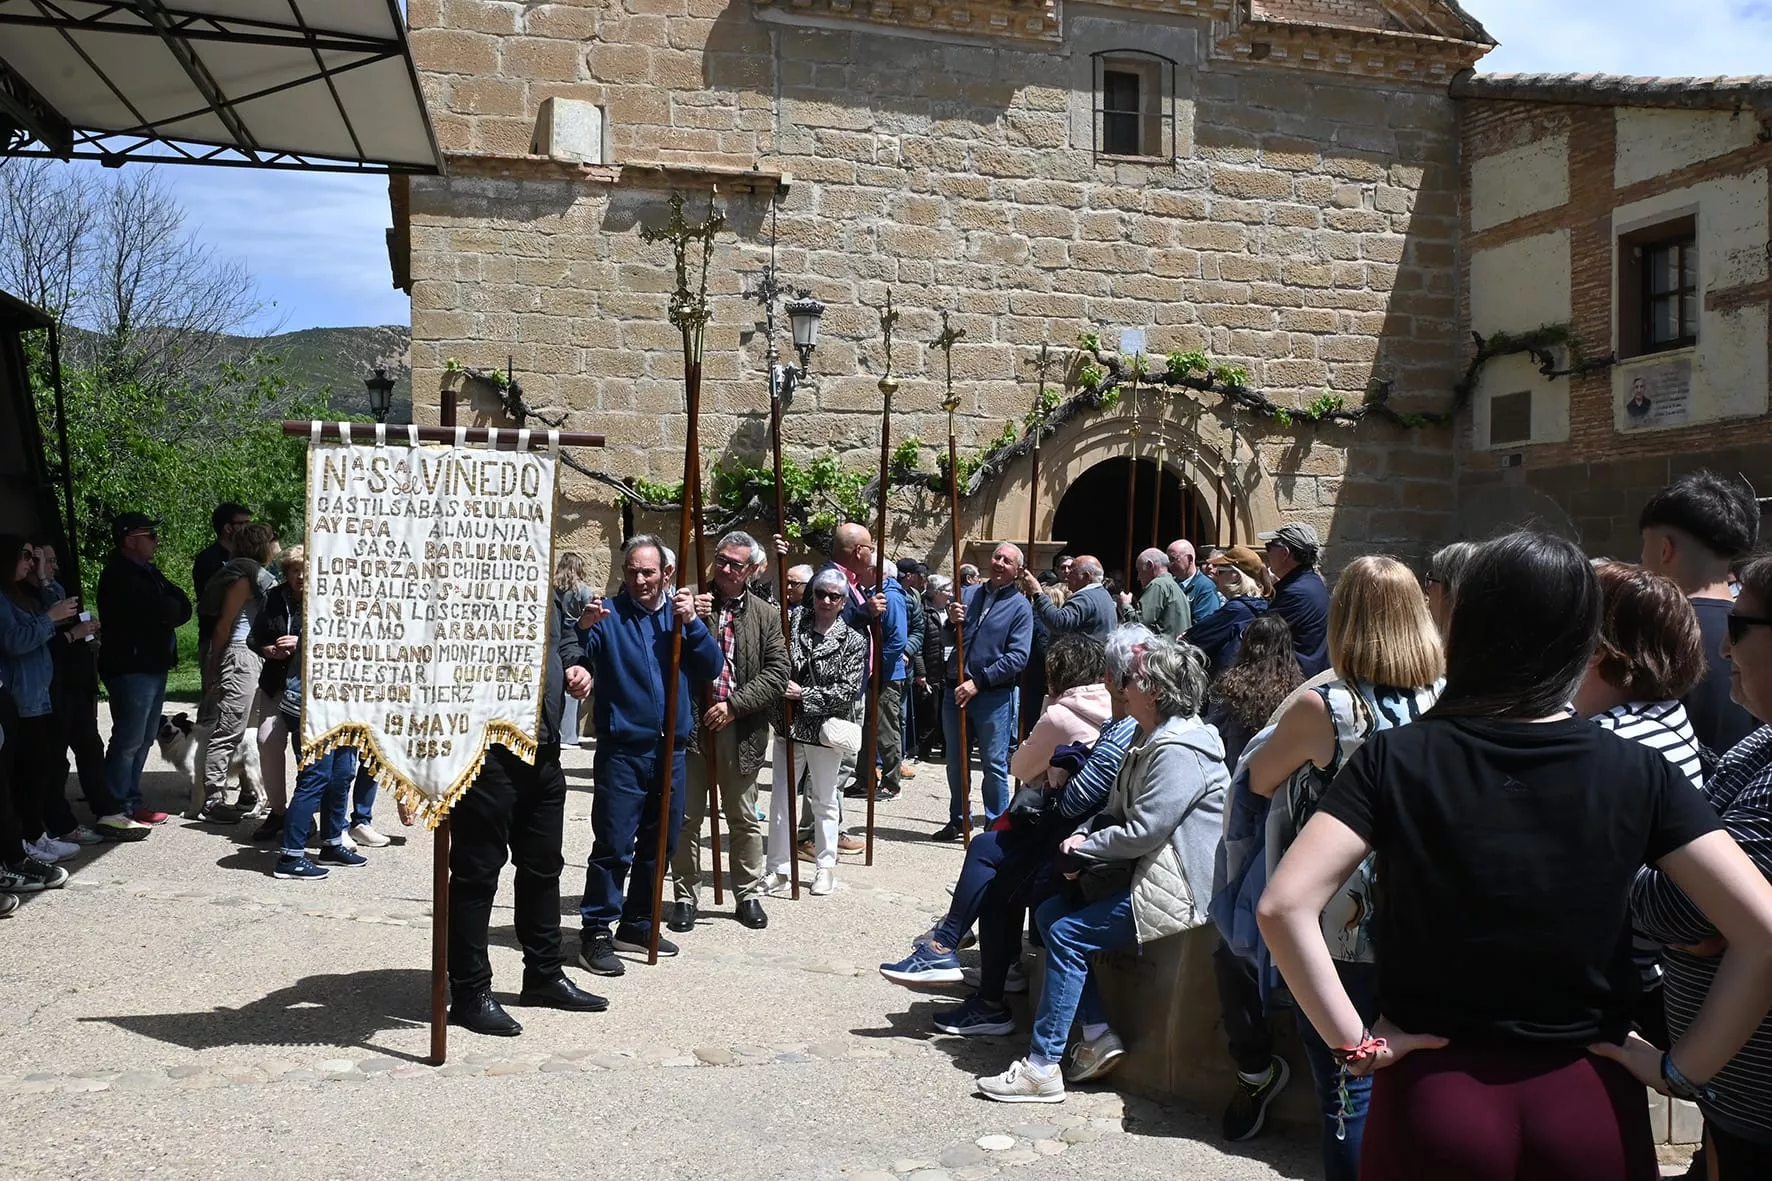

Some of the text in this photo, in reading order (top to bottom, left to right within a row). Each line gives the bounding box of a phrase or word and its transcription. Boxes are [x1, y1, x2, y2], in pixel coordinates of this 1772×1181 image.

[389, 474, 422, 495] del
[422, 455, 540, 498] VIÑEDO
[318, 496, 459, 519] CASTILSABAS
[314, 515, 391, 538] AYERA
[428, 520, 529, 543] ALMUNIA
[354, 539, 411, 558] SASA
[424, 541, 536, 562] BARLUENGA
[317, 557, 449, 580] LOPORZANO
[453, 562, 539, 581] CHIBLUCO
[317, 577, 431, 600] BANDALIÉS
[333, 598, 401, 620] SIPÁN
[412, 602, 538, 623] LOSCERTALES
[434, 619, 538, 641] ARBANIÉS
[312, 643, 433, 663] COSCULLANO
[438, 644, 536, 664] MONFLORITE
[312, 663, 427, 684] BELLESTAR
[454, 665, 532, 683] QUICENA
[312, 683, 411, 703] CASTEJON
[420, 685, 475, 704] TIERZ
[497, 681, 531, 701] OLÁ
[383, 713, 470, 737] 19 MAYO
